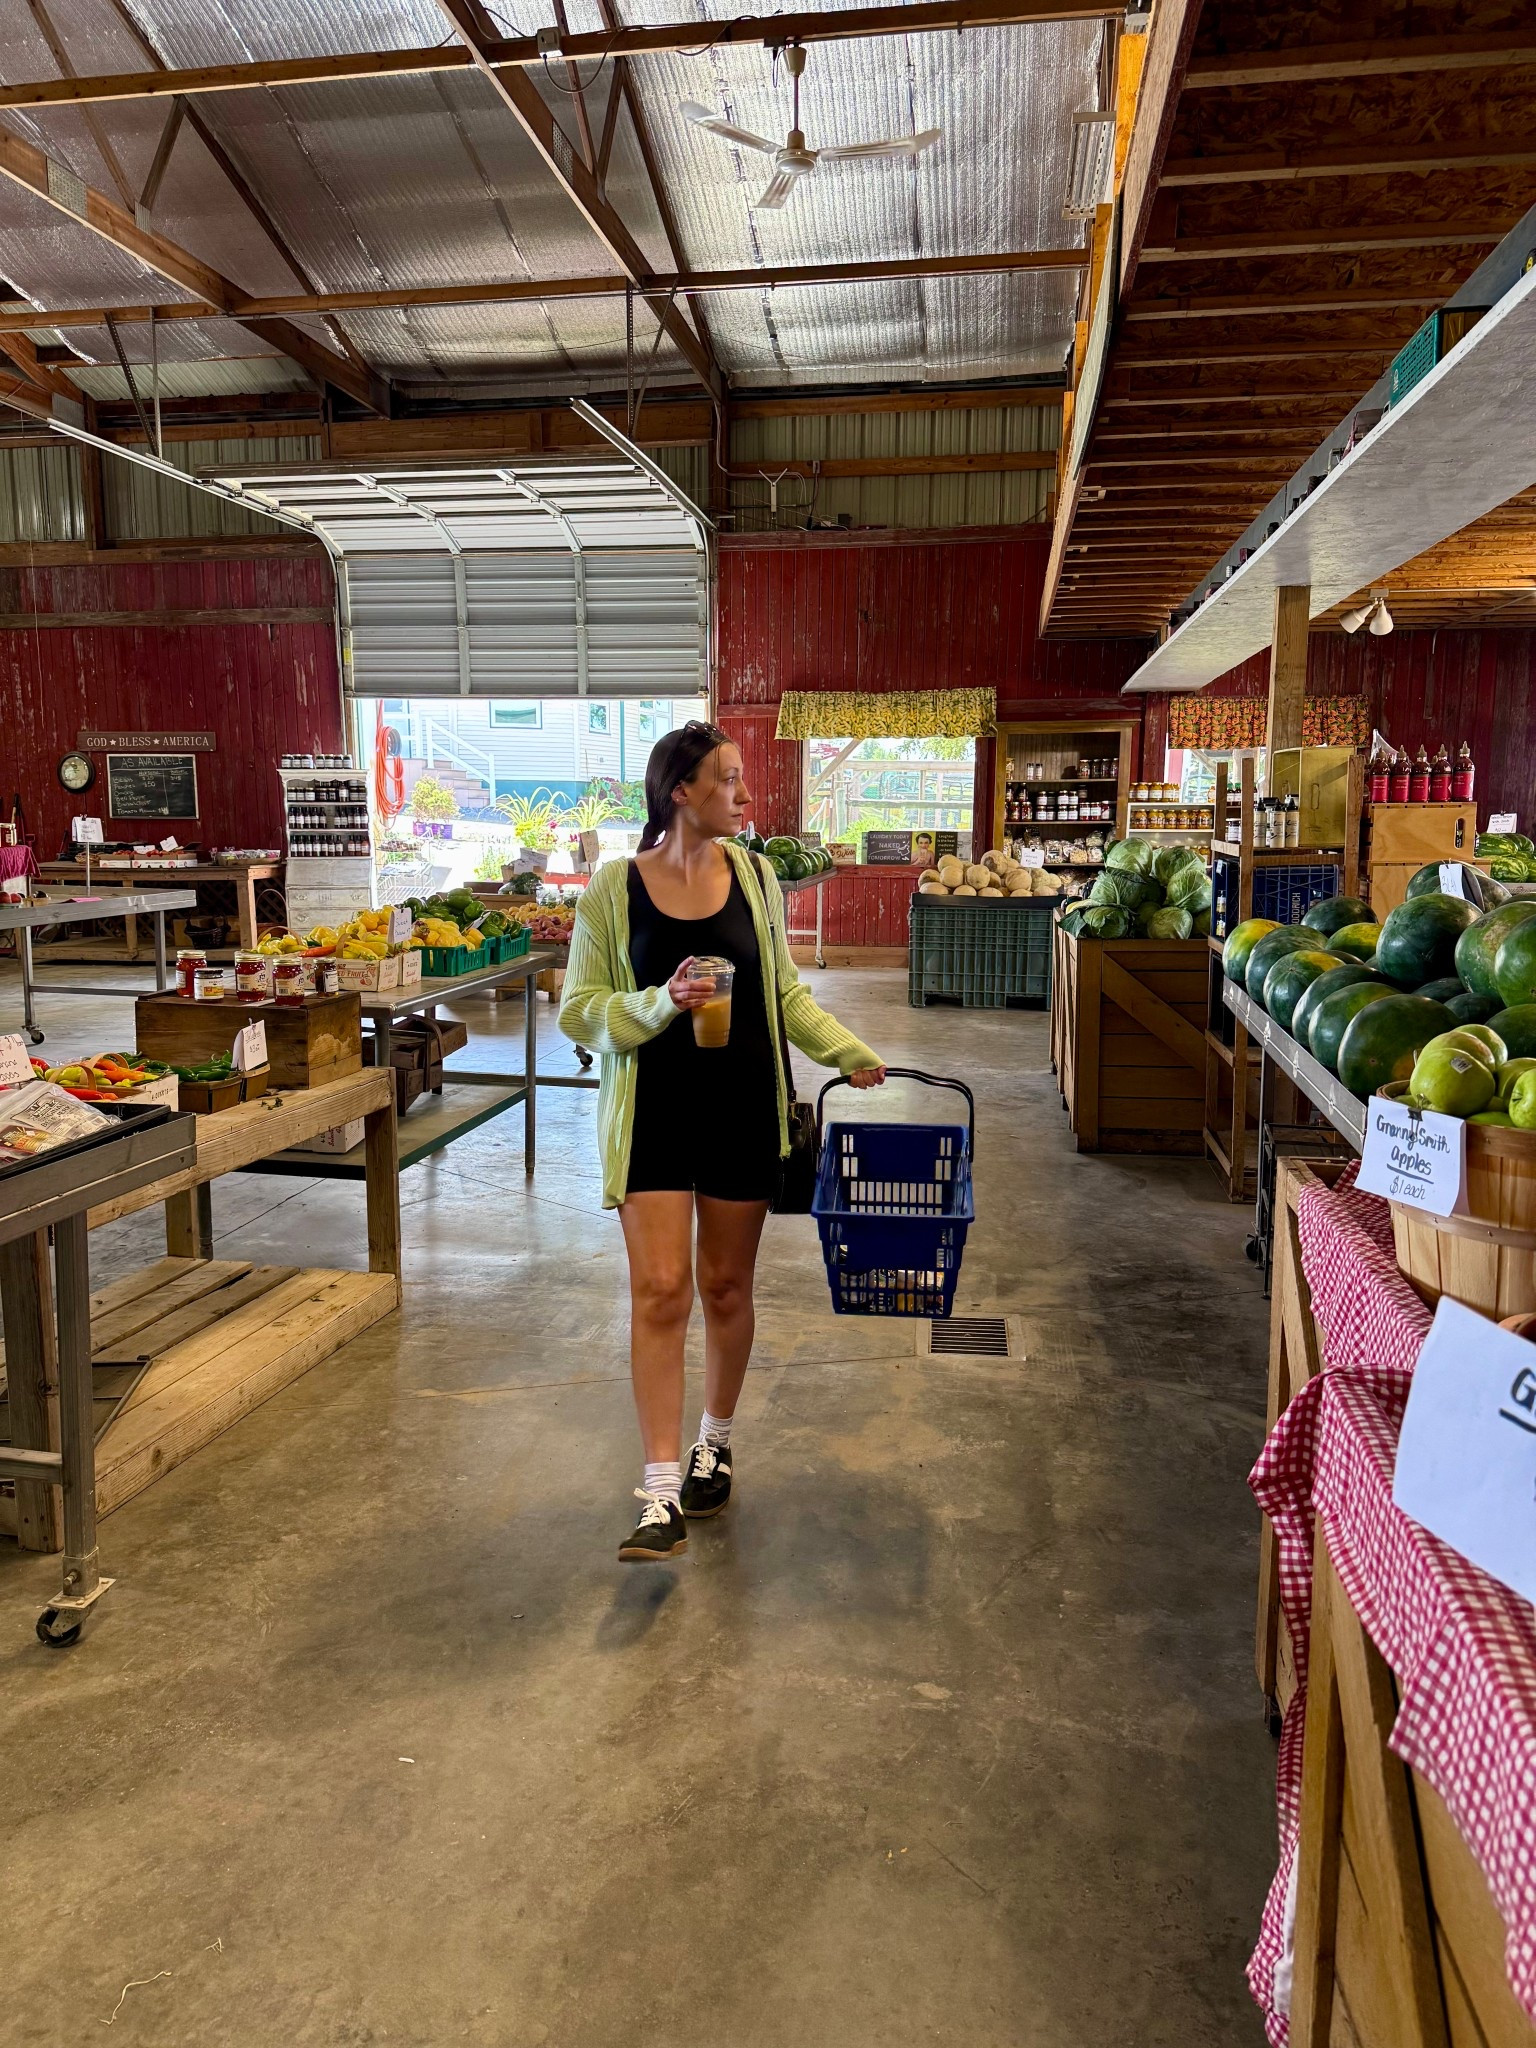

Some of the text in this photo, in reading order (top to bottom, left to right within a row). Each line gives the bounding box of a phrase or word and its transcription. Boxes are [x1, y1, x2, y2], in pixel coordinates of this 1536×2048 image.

[86, 736, 209, 747] GOD BLESS AMERICA
[121, 757, 183, 769] AS AVAILABLE
[878, 842, 900, 850] NAKED
[868, 854, 901, 862] TOMORROW
[1376, 1114, 1451, 1154] Granny Smith
[1403, 1182, 1427, 1200] each
